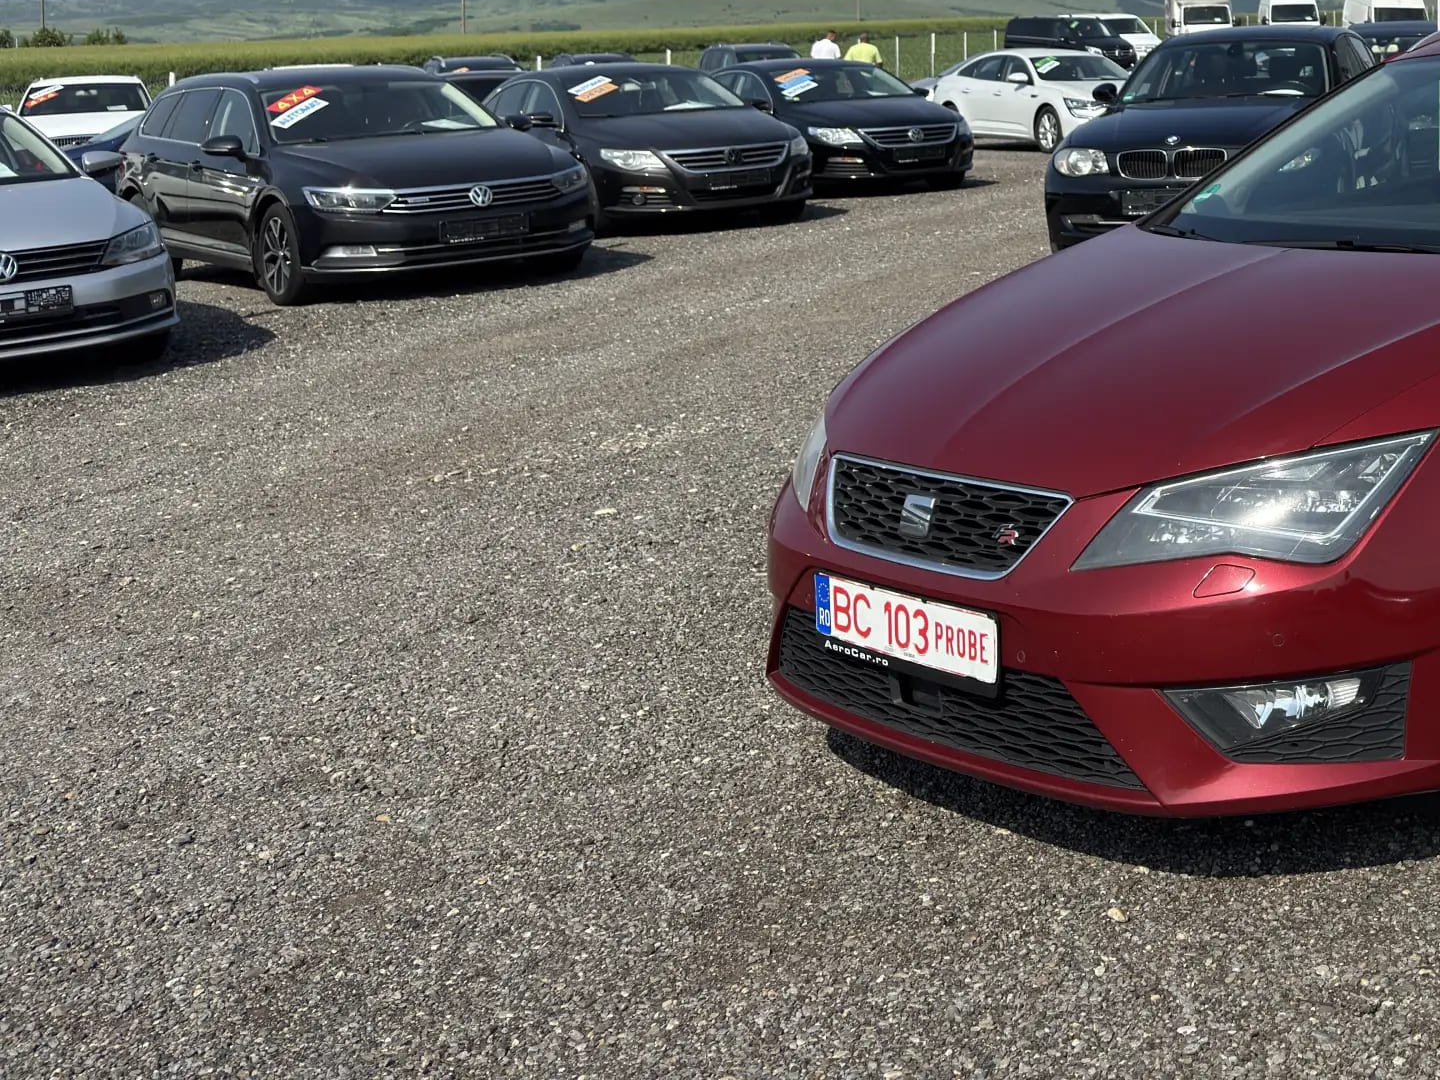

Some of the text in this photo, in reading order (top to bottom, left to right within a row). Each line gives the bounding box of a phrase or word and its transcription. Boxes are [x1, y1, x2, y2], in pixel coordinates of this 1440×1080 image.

[819, 607, 831, 627] RO
[833, 585, 989, 664] BC 103 PROBE
[824, 639, 889, 667] AeroCar.ro
